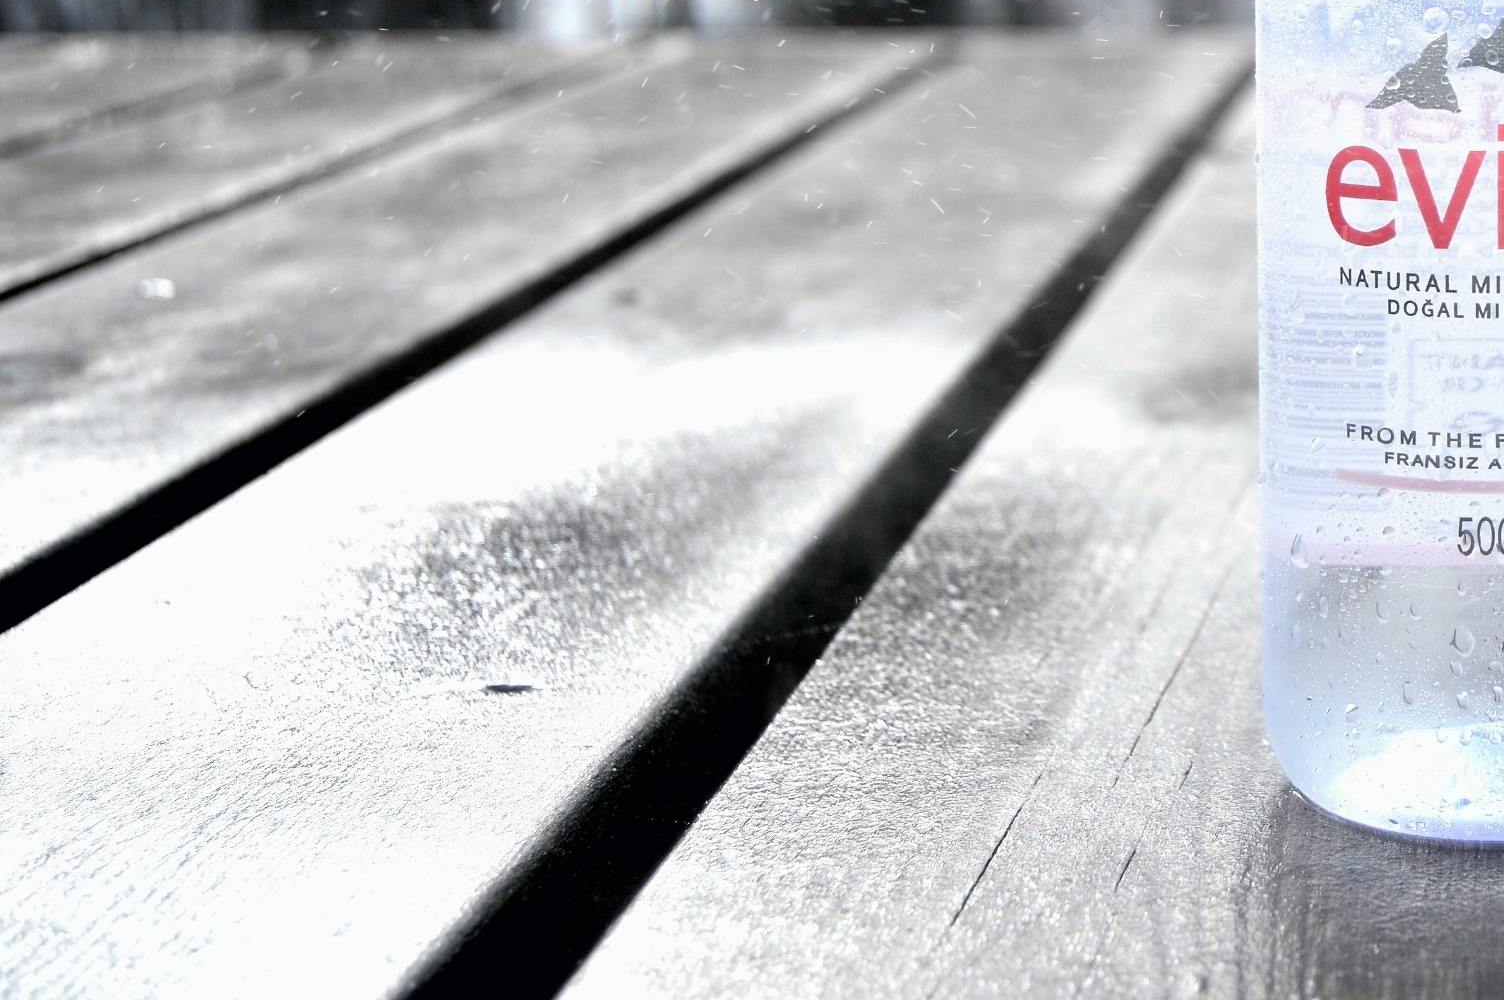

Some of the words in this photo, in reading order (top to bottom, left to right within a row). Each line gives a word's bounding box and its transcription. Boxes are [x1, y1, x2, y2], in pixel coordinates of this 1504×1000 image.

[1339, 266, 1457, 293] NATURAL
[1387, 298, 1464, 318] DOĞAL
[1346, 423, 1417, 446] FROM
[1428, 431, 1482, 449] THE
[1384, 451, 1479, 469] FRANSIZ
